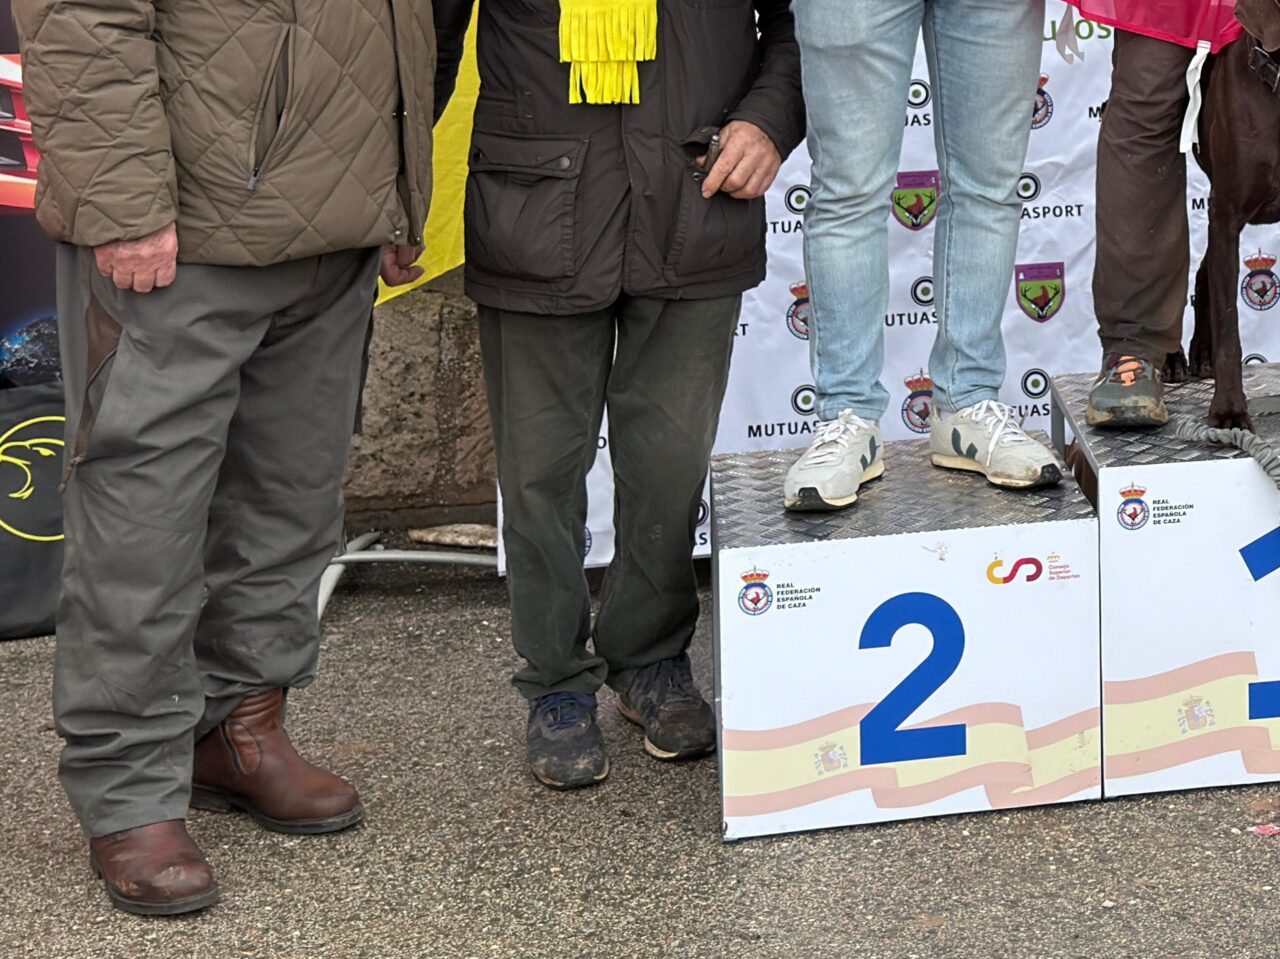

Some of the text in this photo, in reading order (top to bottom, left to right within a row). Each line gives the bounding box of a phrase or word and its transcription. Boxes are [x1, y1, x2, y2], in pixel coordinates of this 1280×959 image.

[1021, 205, 1083, 220] ASPORT
[1152, 503, 1194, 511] FEDERACIÓN
[858, 592, 967, 766] 2
